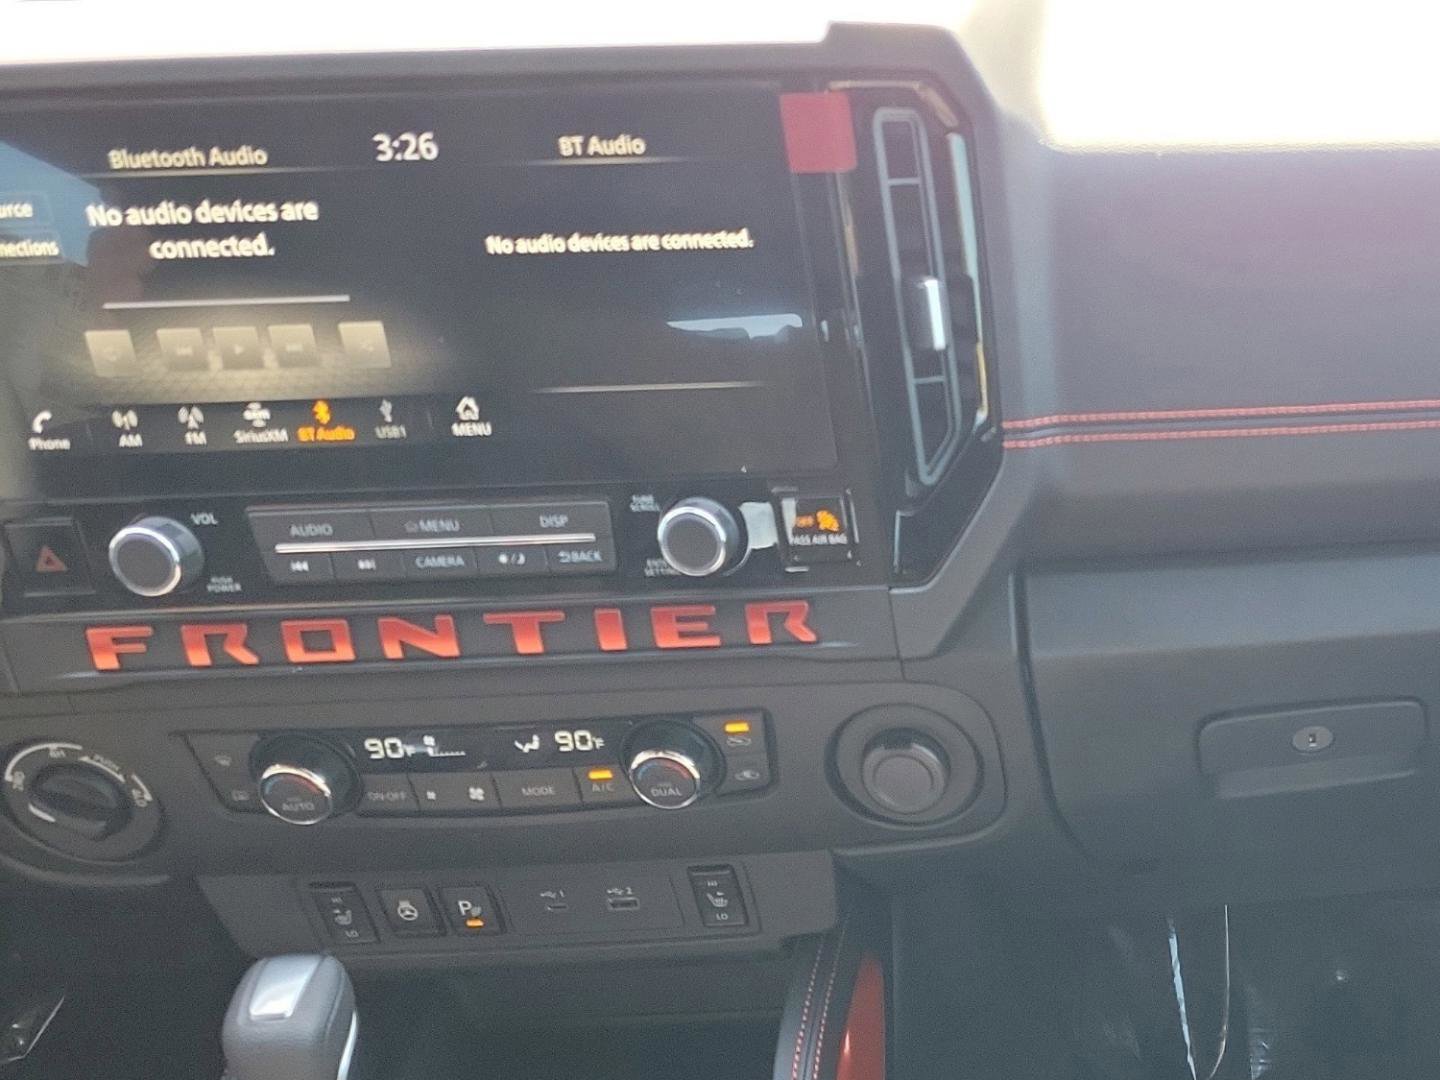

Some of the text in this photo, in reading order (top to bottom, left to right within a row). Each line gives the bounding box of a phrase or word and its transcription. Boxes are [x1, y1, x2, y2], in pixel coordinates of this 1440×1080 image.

[372, 131, 439, 162] 3:26
[558, 134, 646, 156] BT Audio
[108, 144, 268, 170] Bluetooth Audio
[86, 199, 319, 227] No audio devices are
[150, 231, 275, 260] connected.
[486, 228, 754, 254] No audio devices are connected.
[317, 425, 356, 441] Audio
[451, 421, 492, 437] MENU
[119, 433, 143, 447] AM
[185, 431, 207, 445] FM
[191, 512, 218, 526] VOL
[419, 519, 460, 533] MENU
[539, 514, 569, 529] DISP
[290, 523, 334, 537] AUDIO
[415, 554, 465, 569] CAMERA
[569, 550, 602, 564] BACK
[206, 583, 242, 593] POWER
[86, 600, 819, 670] FRONTIER
[522, 786, 555, 797] MODE
[592, 782, 615, 793] A/C
[652, 786, 683, 798] DUAL
[282, 802, 315, 812] AUTO
